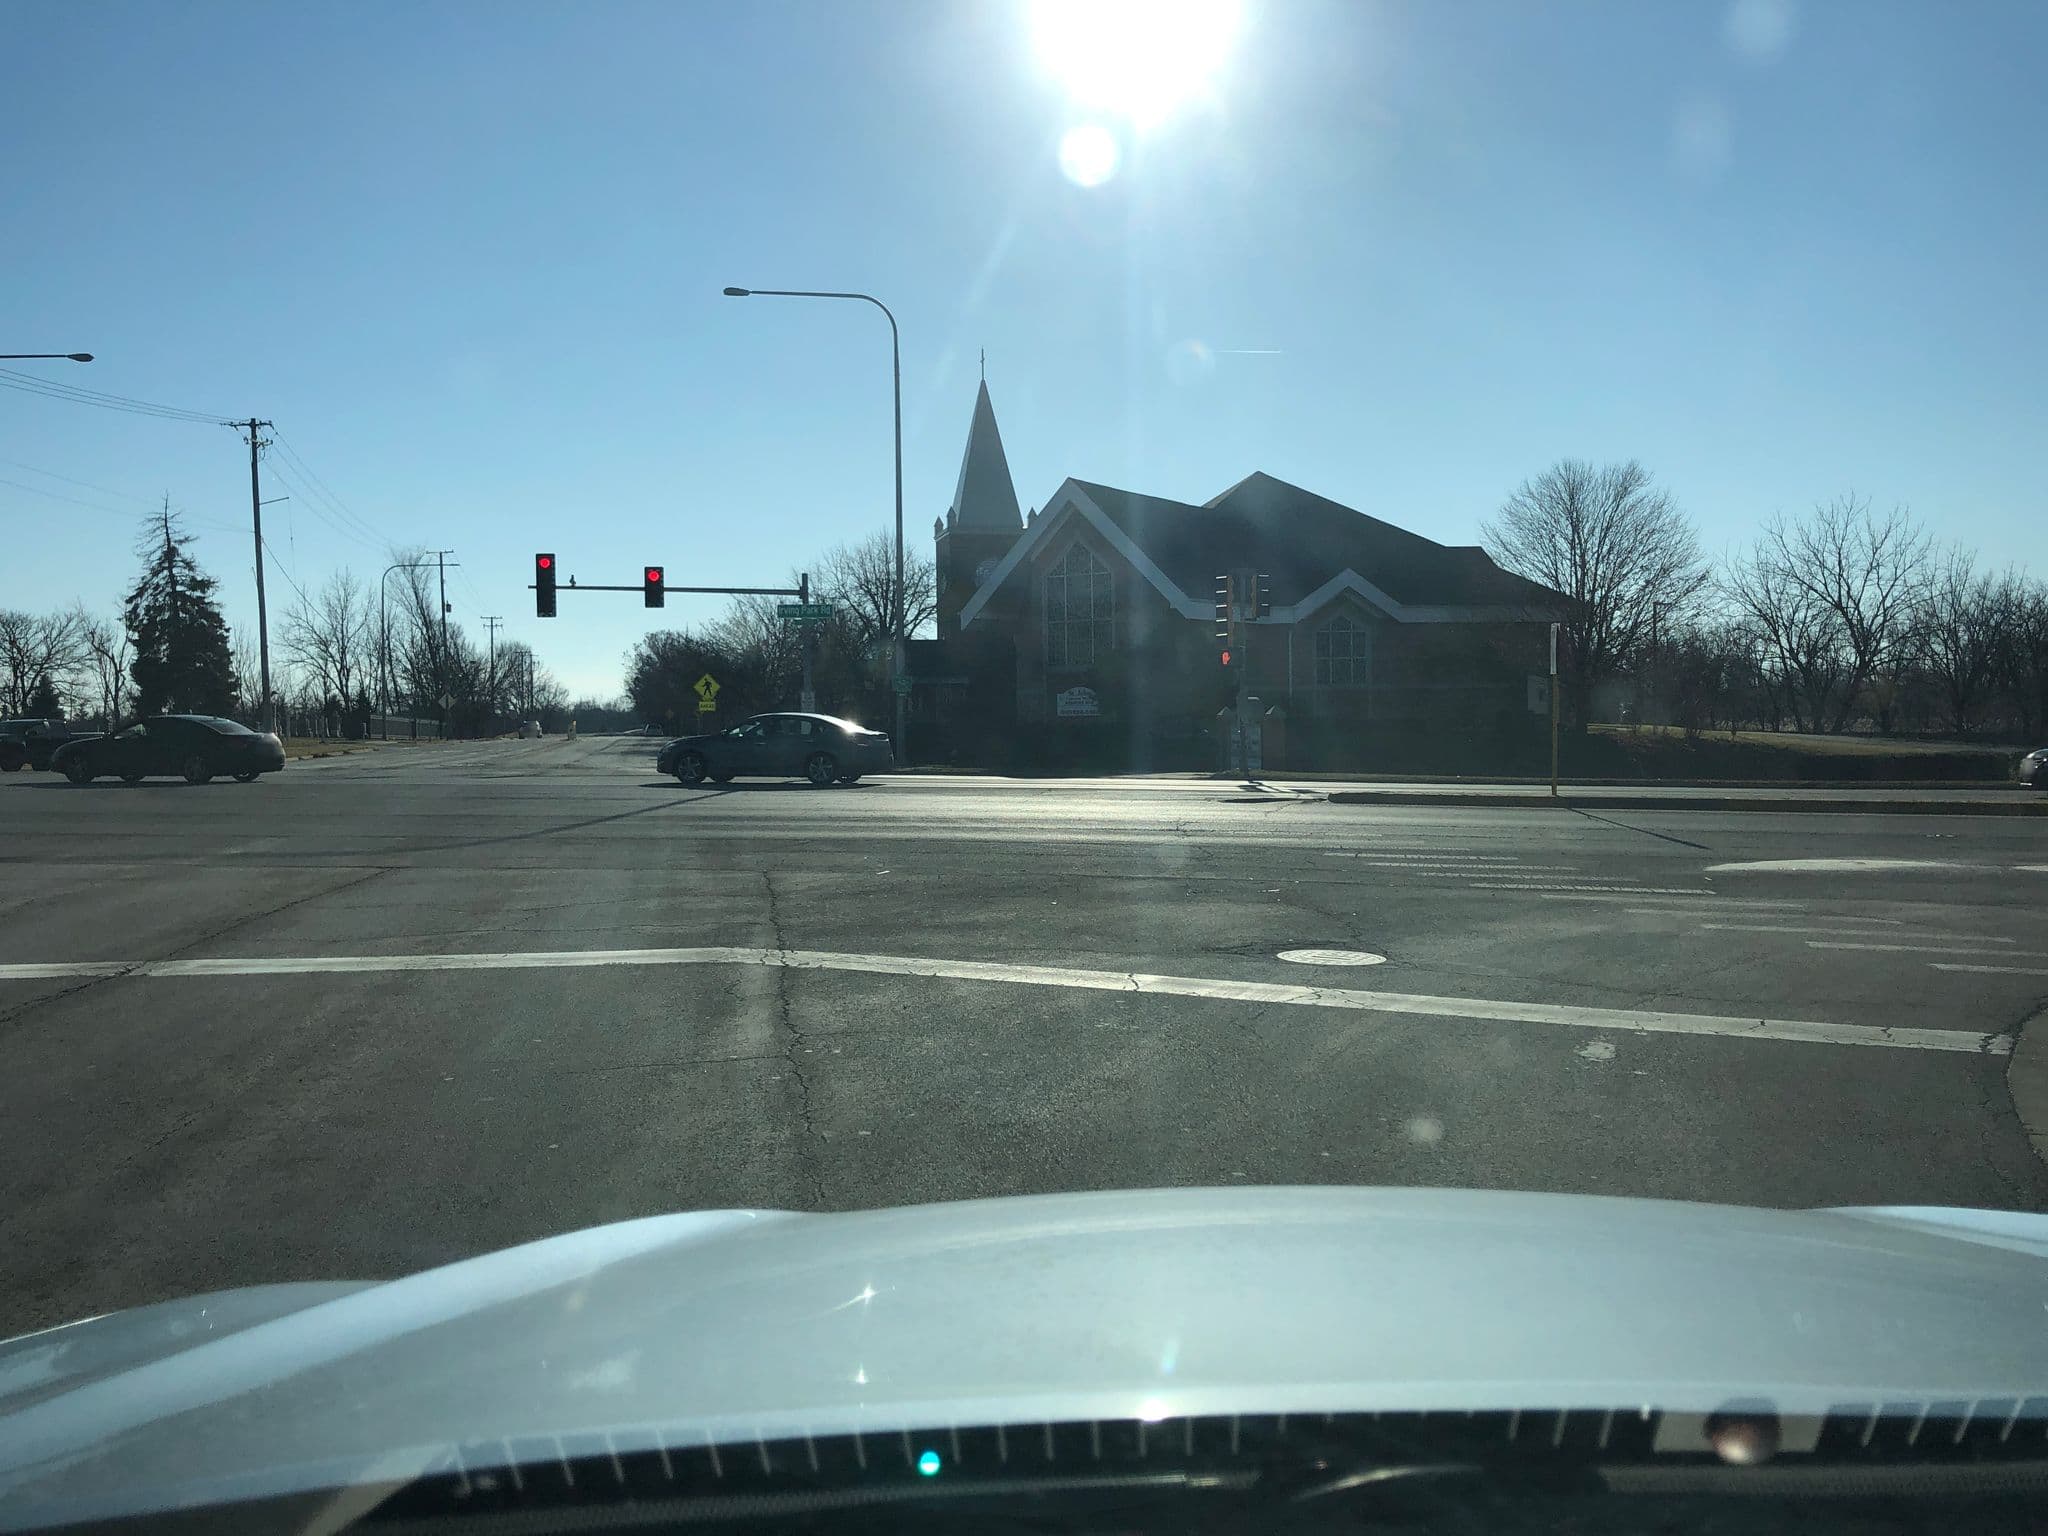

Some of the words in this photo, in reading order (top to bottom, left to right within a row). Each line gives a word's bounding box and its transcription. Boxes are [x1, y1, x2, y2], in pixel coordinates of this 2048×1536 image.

[778, 606, 800, 617] Irving
[801, 606, 819, 615] Park
[821, 606, 831, 615] Rd
